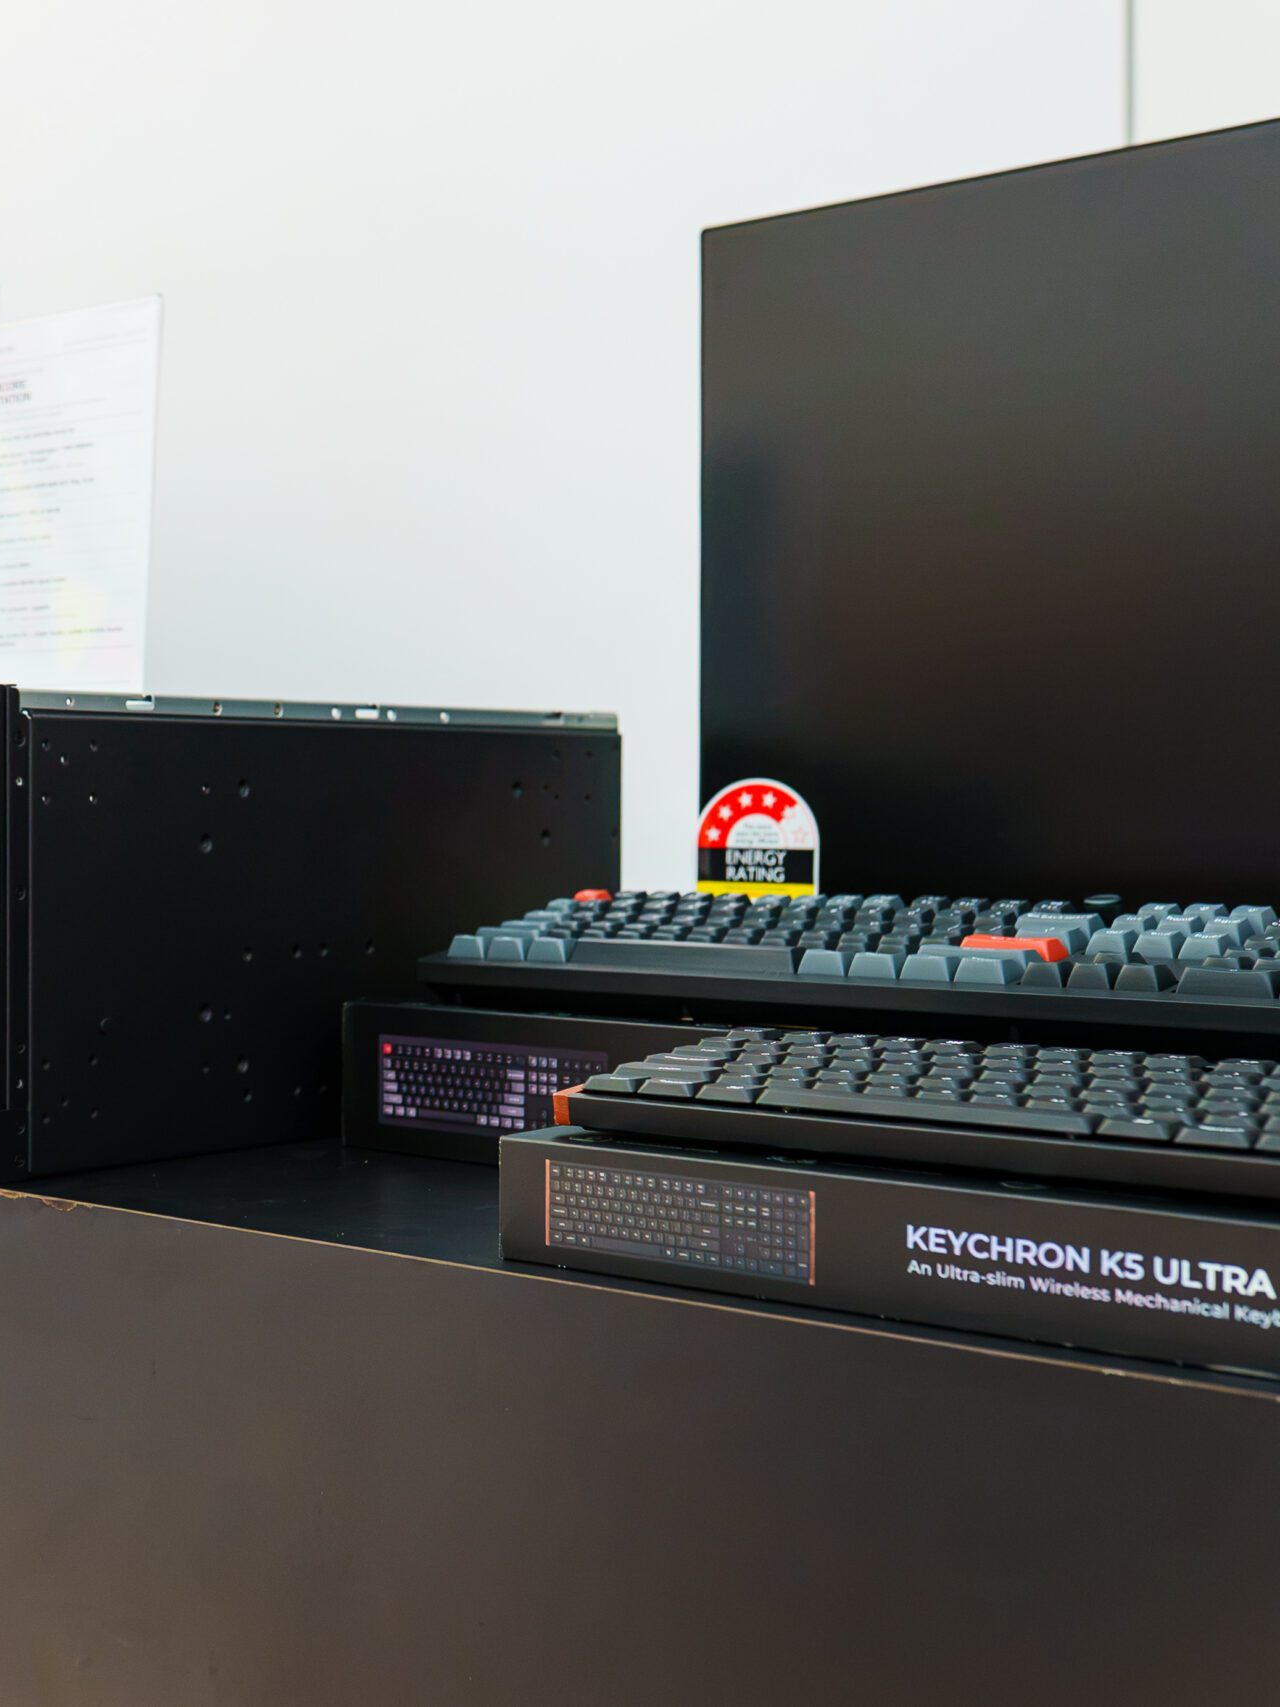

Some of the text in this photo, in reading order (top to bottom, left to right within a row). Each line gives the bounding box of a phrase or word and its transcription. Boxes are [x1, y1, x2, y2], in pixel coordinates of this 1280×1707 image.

[725, 849, 787, 867] ENERGY
[725, 866, 785, 883] RATING
[906, 1224, 1277, 1300] KEYCHRON K5 ULTRA
[907, 1259, 932, 1276] An
[936, 1263, 1025, 1290] Ultra-slim
[1029, 1276, 1111, 1303] Wireless
[1114, 1287, 1230, 1320] Mechanical
